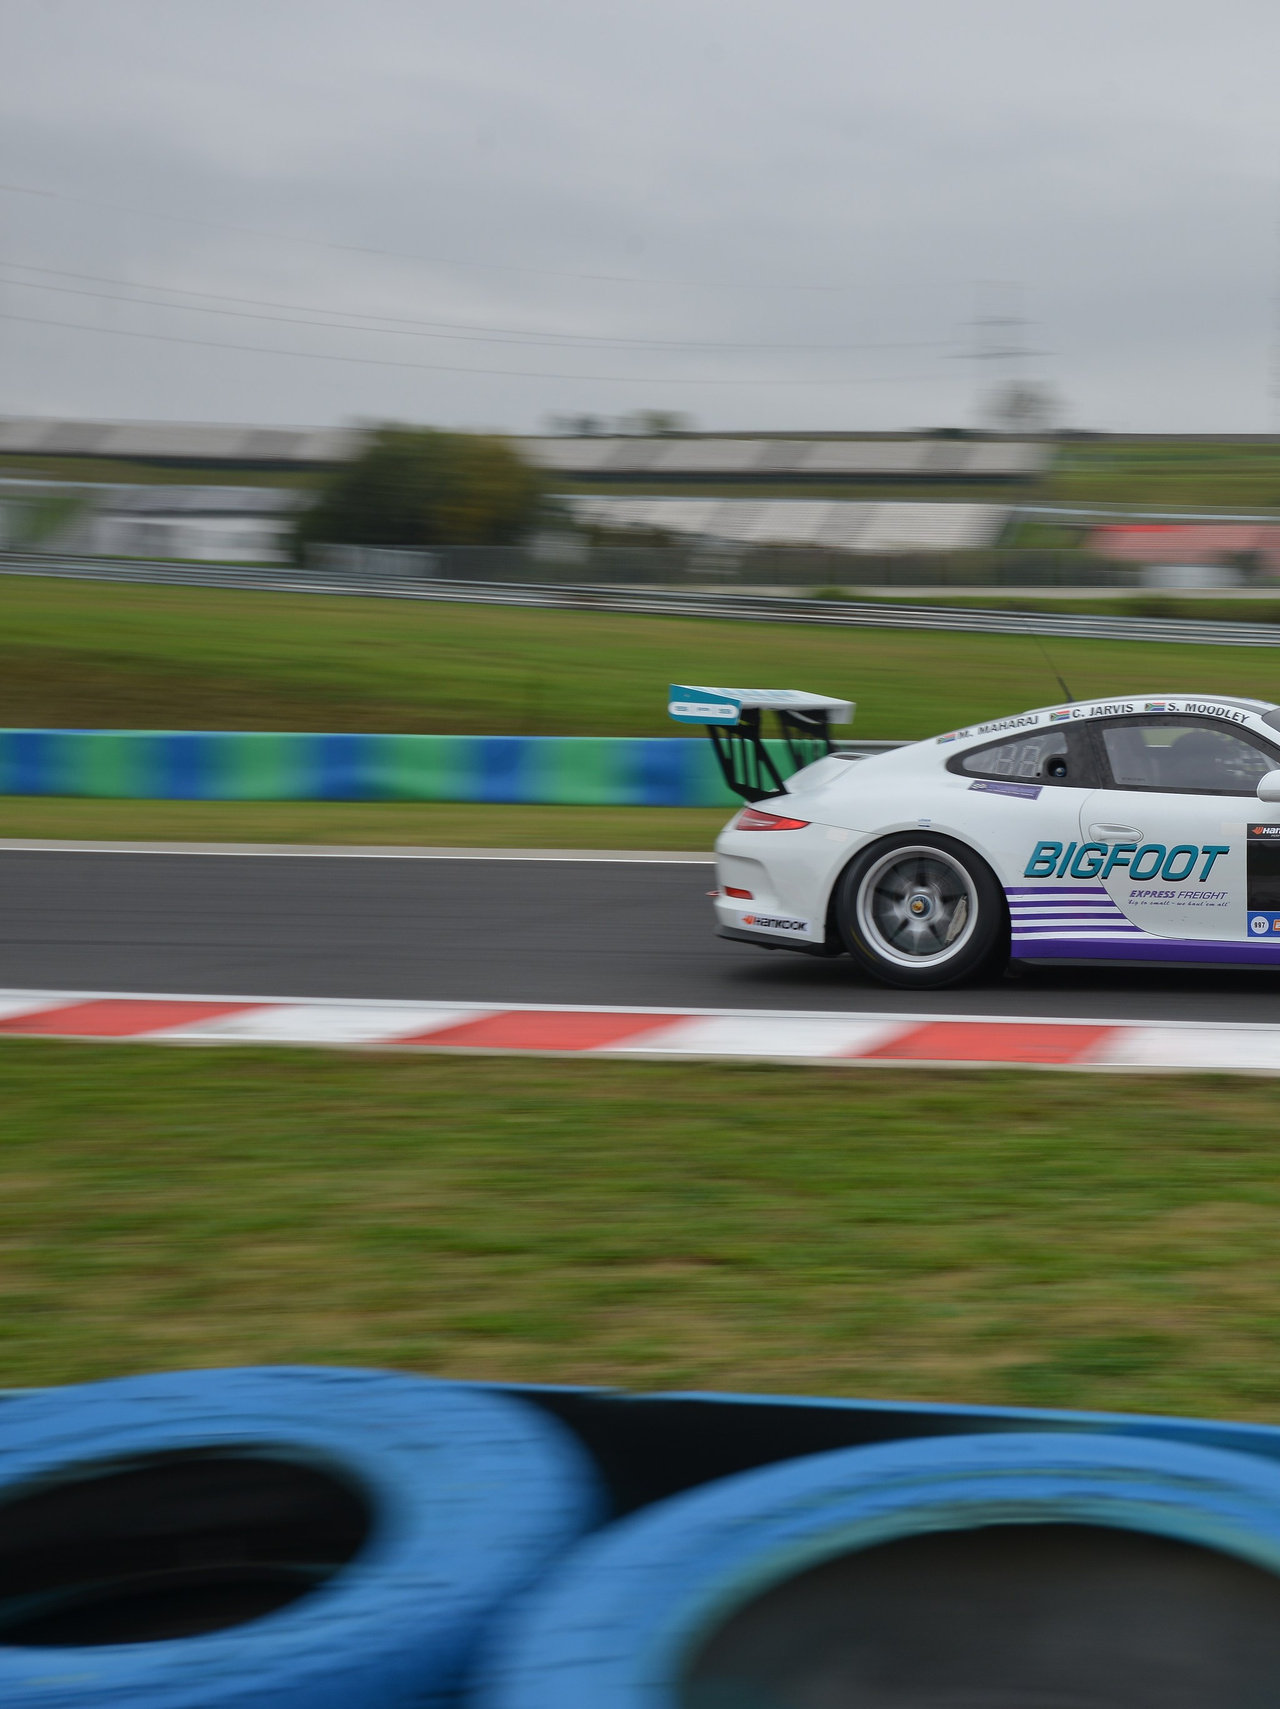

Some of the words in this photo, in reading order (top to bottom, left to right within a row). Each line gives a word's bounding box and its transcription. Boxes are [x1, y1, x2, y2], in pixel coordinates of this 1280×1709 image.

[1072, 709, 1085, 718] C.
[1089, 703, 1133, 717] JARVIS
[1168, 702, 1180, 712] S.
[1185, 703, 1249, 723] MOODLEY
[978, 716, 1039, 735] MAHARAJ
[1024, 841, 1230, 882] BIGFOOT
[1129, 890, 1176, 898] EXPRESS
[1177, 891, 1229, 900] FREIGHT
